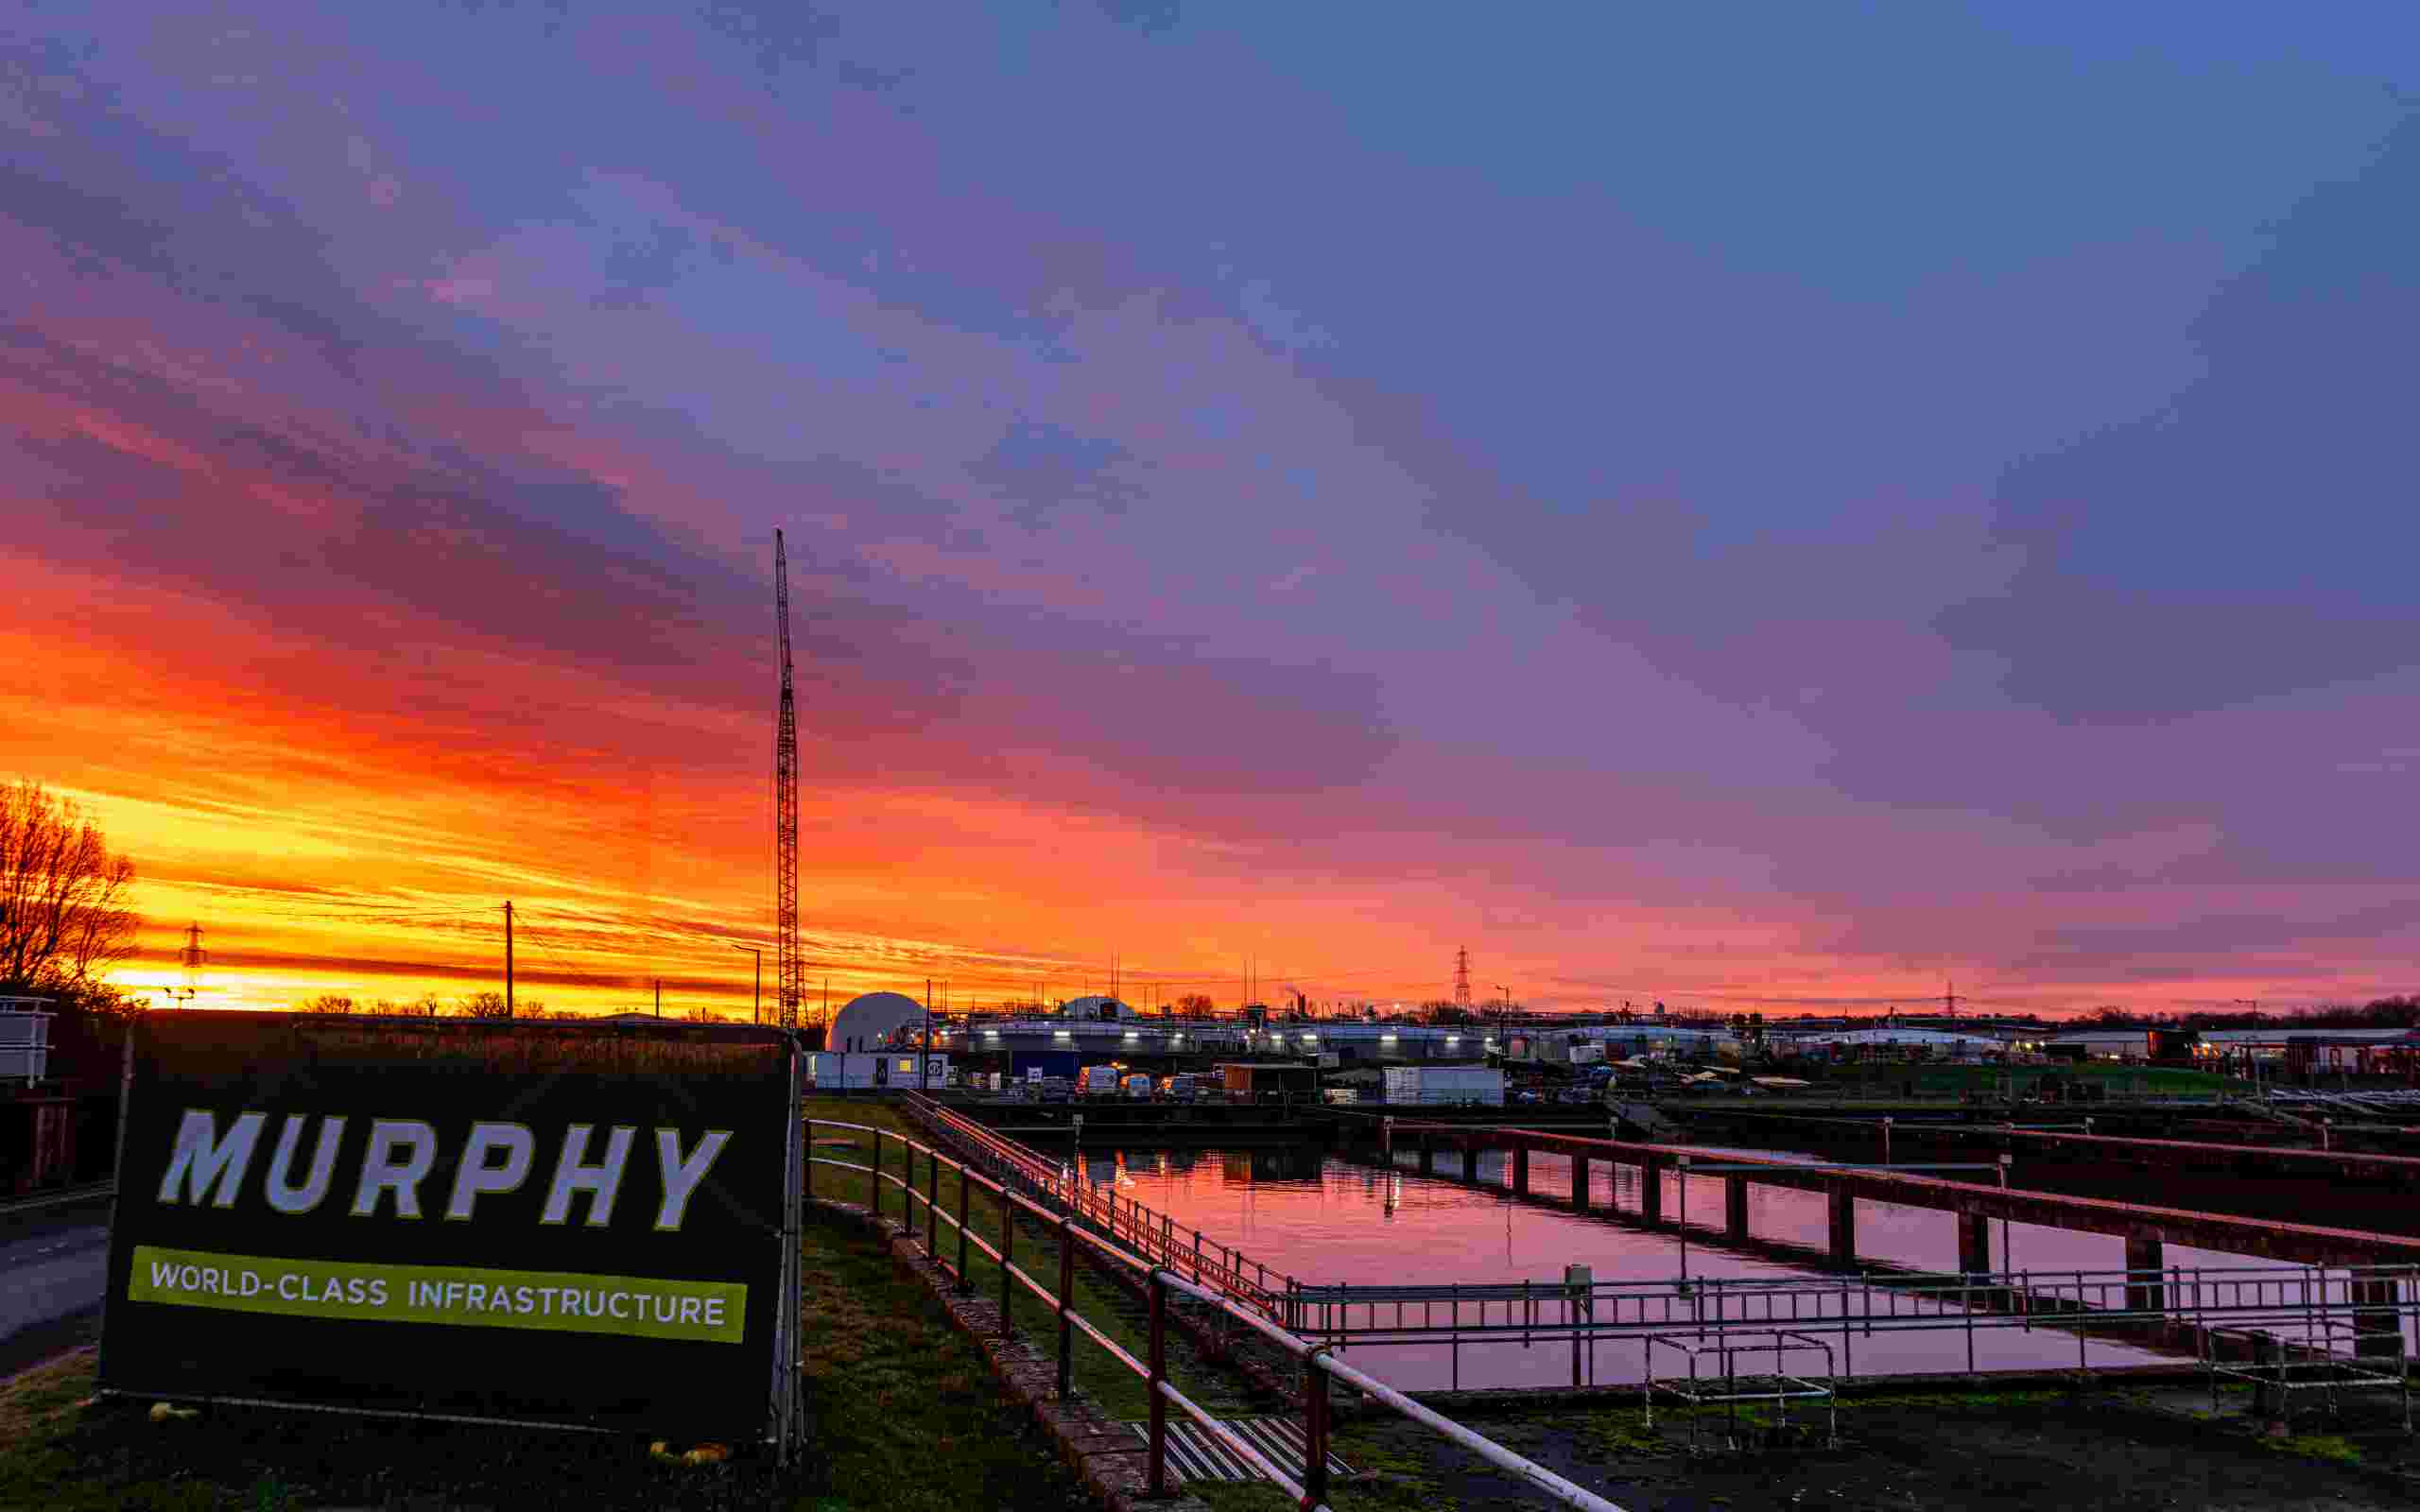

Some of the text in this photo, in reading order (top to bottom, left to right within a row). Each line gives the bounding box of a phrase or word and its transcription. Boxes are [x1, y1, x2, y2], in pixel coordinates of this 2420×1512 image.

[157, 1109, 735, 1231] MURPHY
[150, 1262, 726, 1326] WORLD-CLASS INFRASTRUCTURE
